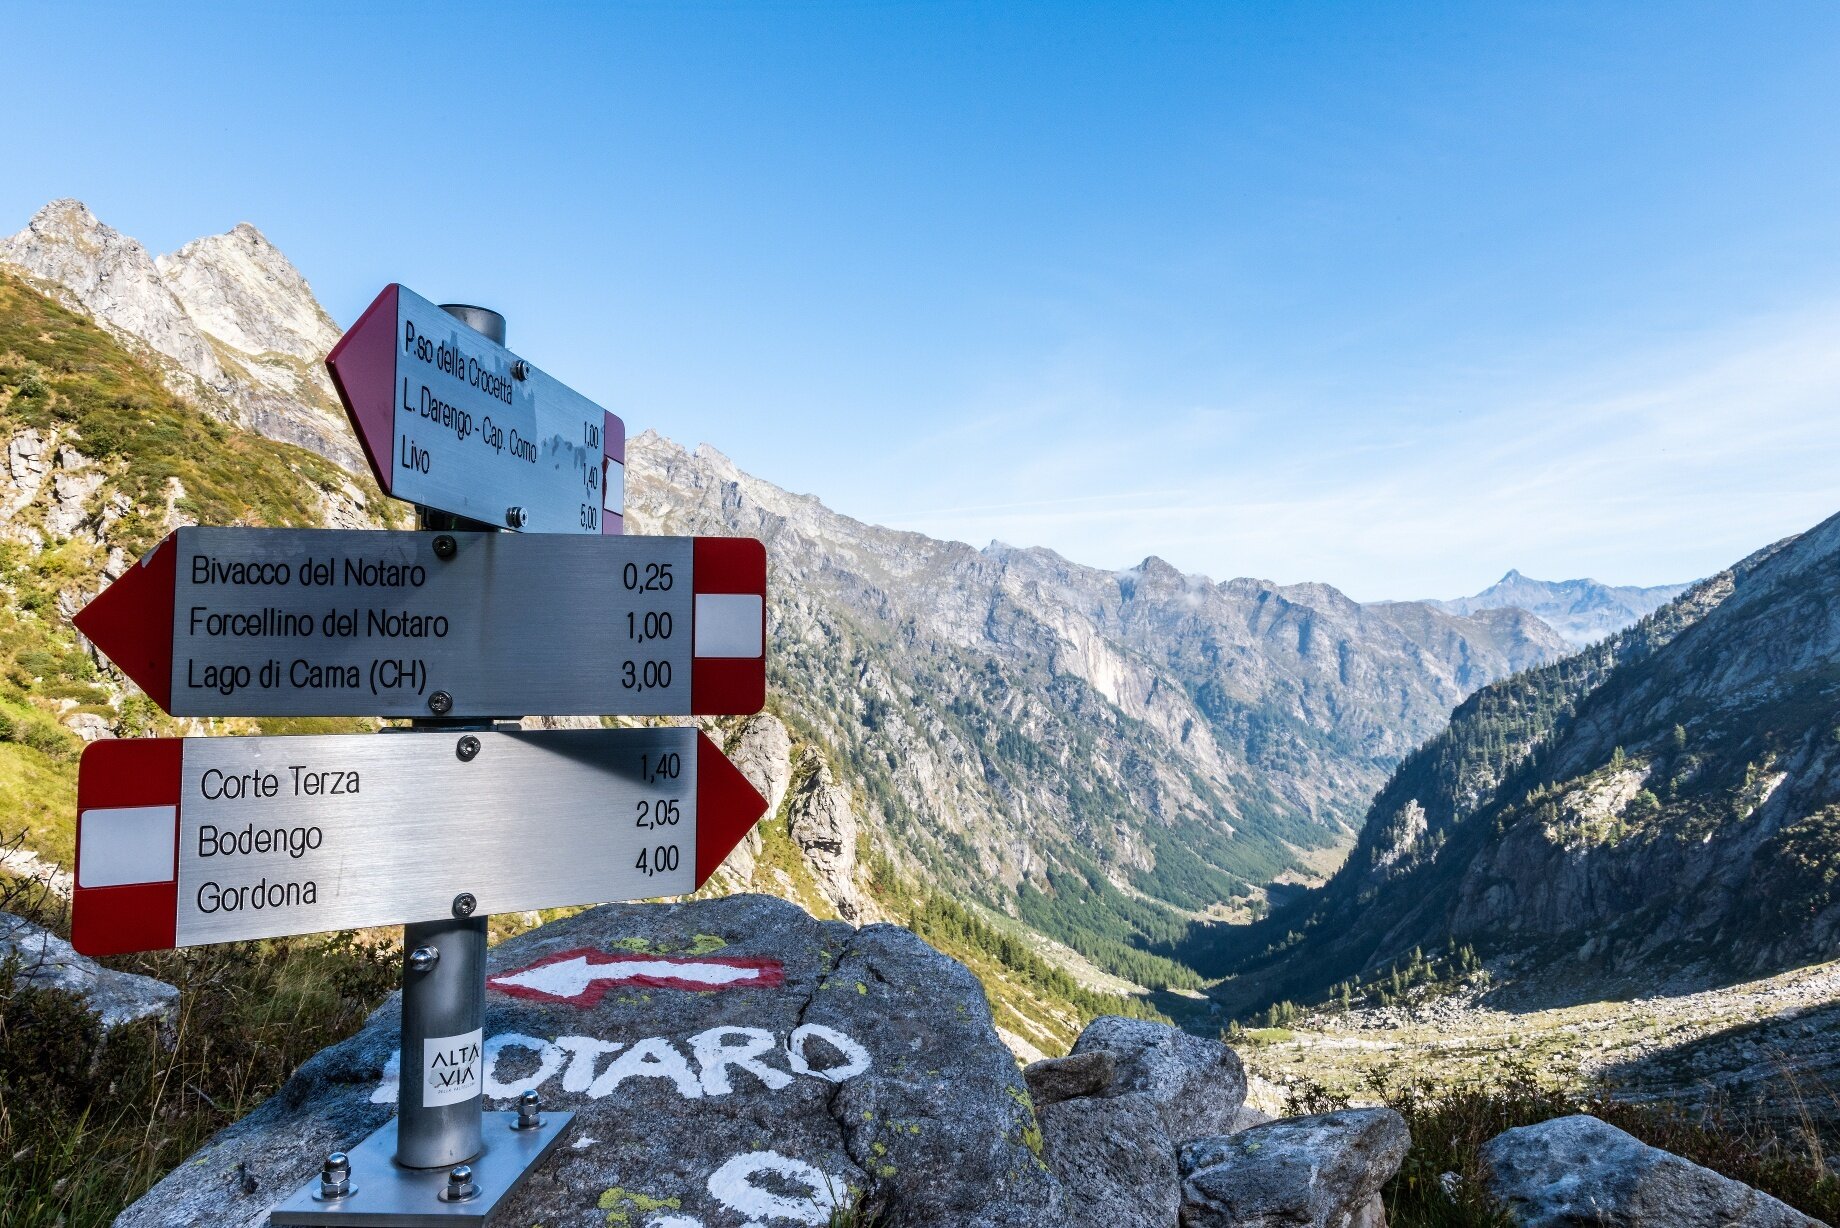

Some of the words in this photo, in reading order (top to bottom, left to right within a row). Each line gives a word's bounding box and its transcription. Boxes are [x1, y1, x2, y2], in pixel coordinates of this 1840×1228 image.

[405, 320, 433, 363] P.so
[437, 339, 465, 381] della
[469, 358, 512, 405] Crocetta
[403, 377, 416, 412] L.
[420, 386, 472, 440] Darengo
[482, 416, 506, 455] Cap.
[509, 428, 537, 463] Como
[584, 421, 599, 449] 1,00
[401, 435, 430, 474] Livo
[192, 556, 290, 585] Bivacco
[299, 557, 334, 586] del
[344, 558, 426, 587] Notaro
[623, 563, 673, 594] 0,25
[190, 607, 314, 636] Forcellino
[322, 608, 358, 637] del
[367, 608, 449, 638] Notaro
[627, 612, 672, 643] 1,00
[188, 658, 250, 696] Lago
[259, 659, 280, 688] di
[289, 659, 360, 688] Cama
[369, 659, 427, 695] (CH)
[621, 660, 672, 693] 3,00
[201, 768, 279, 800] Corte
[288, 765, 360, 796] Terza
[641, 753, 680, 784] 1,40
[636, 799, 680, 830] 2,05
[198, 823, 323, 859] Bodengo
[635, 845, 679, 877] 4,00
[197, 877, 317, 914] Gordona
[431, 1043, 480, 1069] ALTA
[439, 1066, 475, 1087] VIA
